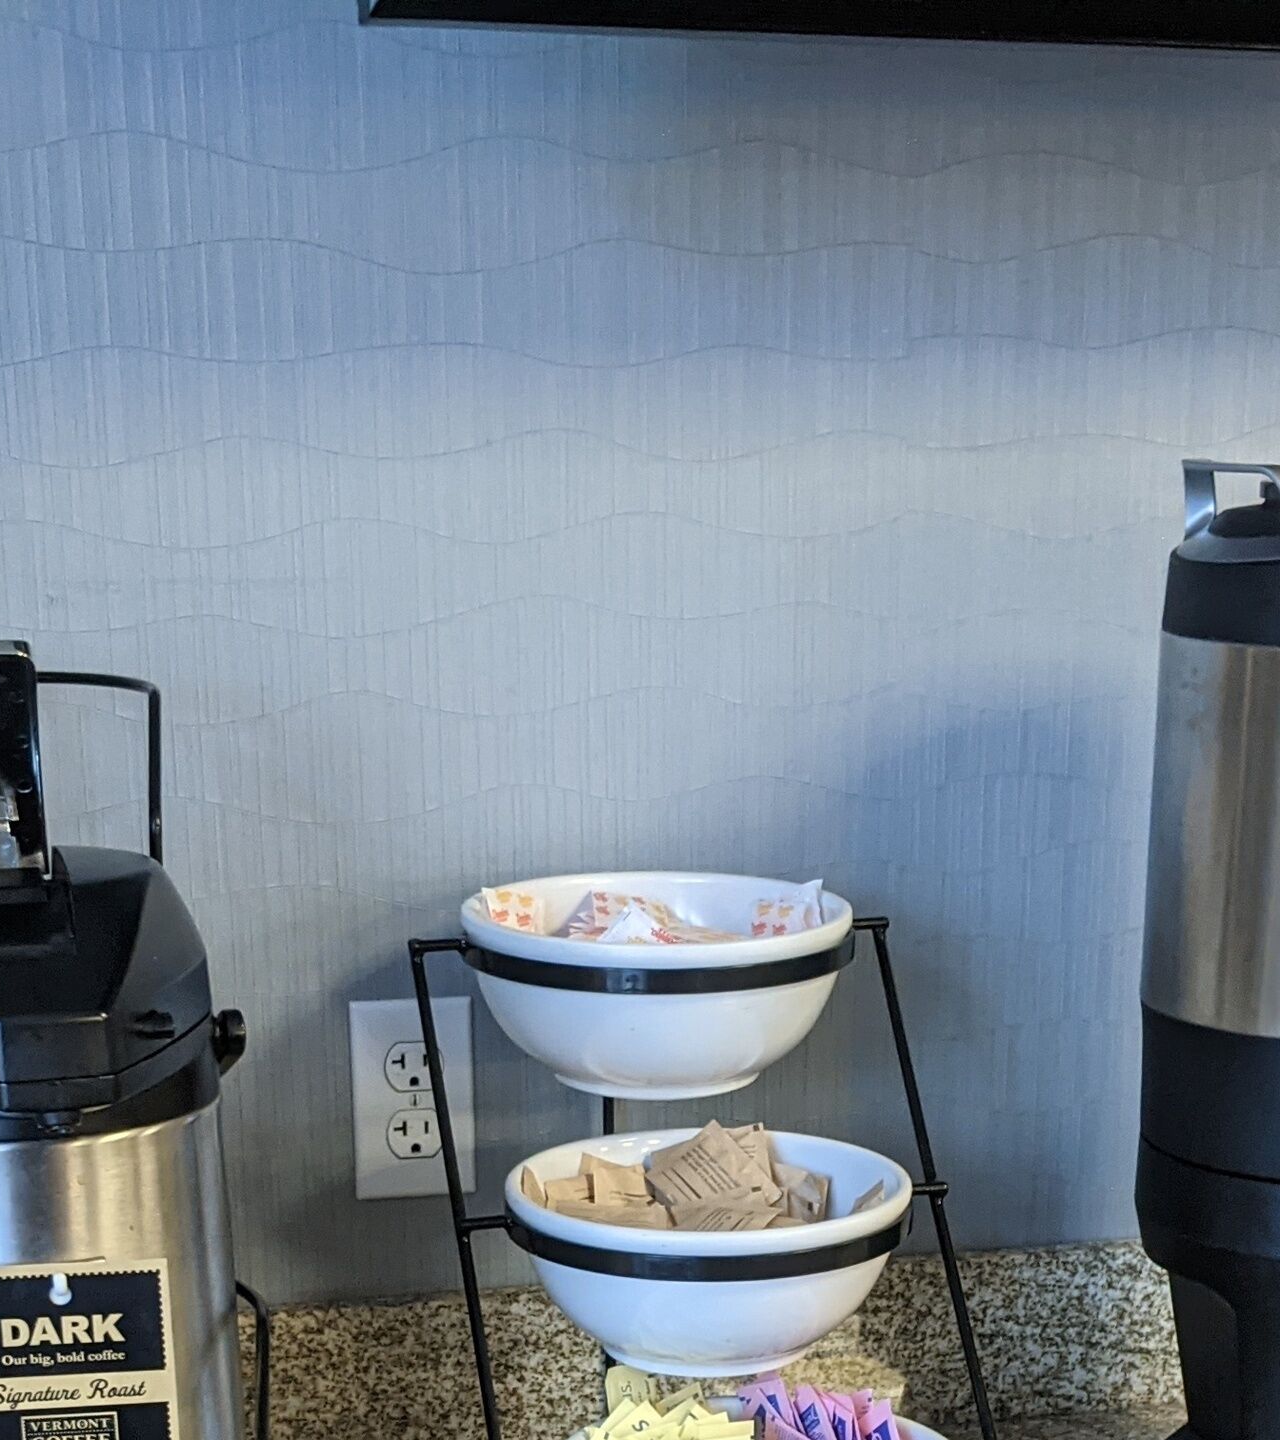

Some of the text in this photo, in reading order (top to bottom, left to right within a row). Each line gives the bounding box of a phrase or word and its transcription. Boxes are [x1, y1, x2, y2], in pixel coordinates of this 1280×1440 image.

[0, 1313, 126, 1348] DARK
[1, 1349, 126, 1368] Our big, bold coffee
[89, 1378, 147, 1399] Roast
[29, 1418, 110, 1432] VERMONT
